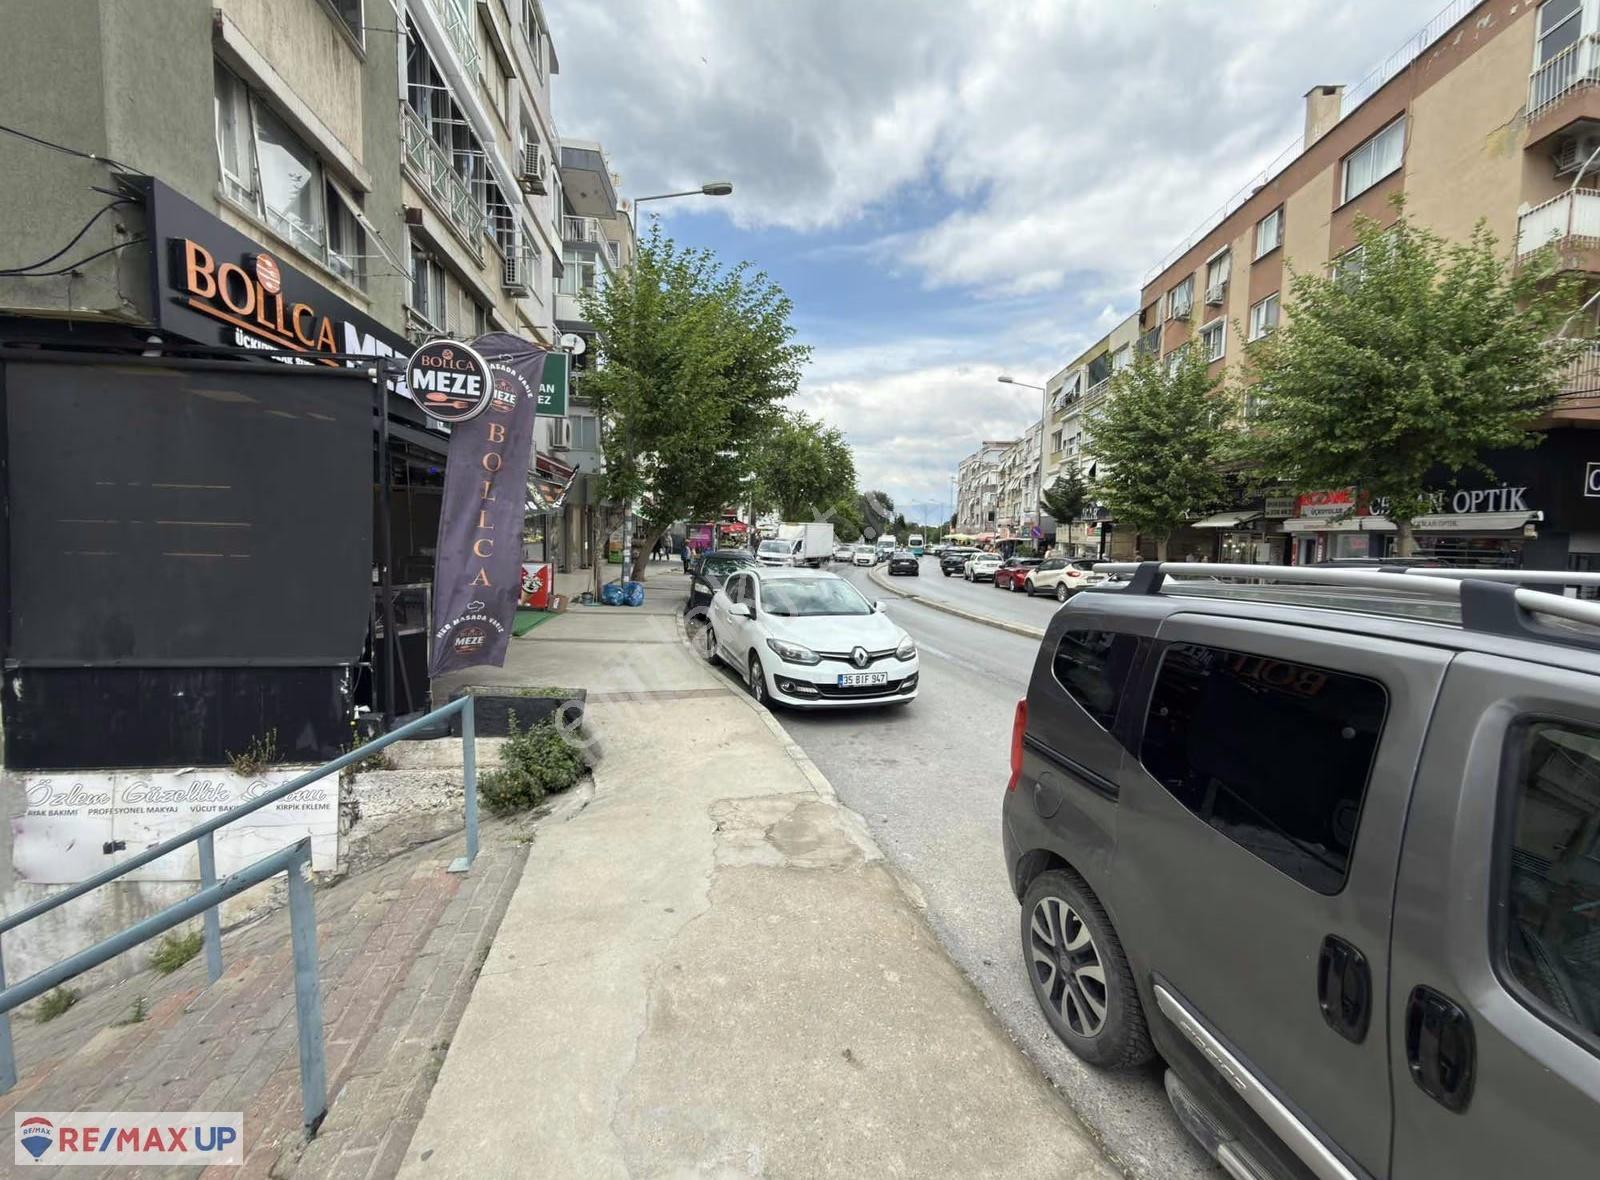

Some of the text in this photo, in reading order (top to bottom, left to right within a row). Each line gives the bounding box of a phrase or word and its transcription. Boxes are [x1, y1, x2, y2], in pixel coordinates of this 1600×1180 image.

[490, 363, 517, 376] ASADA
[412, 368, 481, 396] MEZE
[1452, 482, 1528, 513] OPTİK
[452, 614, 487, 626] MASADA
[455, 636, 485, 646] MEZE
[843, 674, 885, 685] 35 BIF 947
[121, 780, 231, 803] Güzellik
[88, 807, 145, 816] PROFESYONEL
[301, 802, 330, 810] EKLEME
